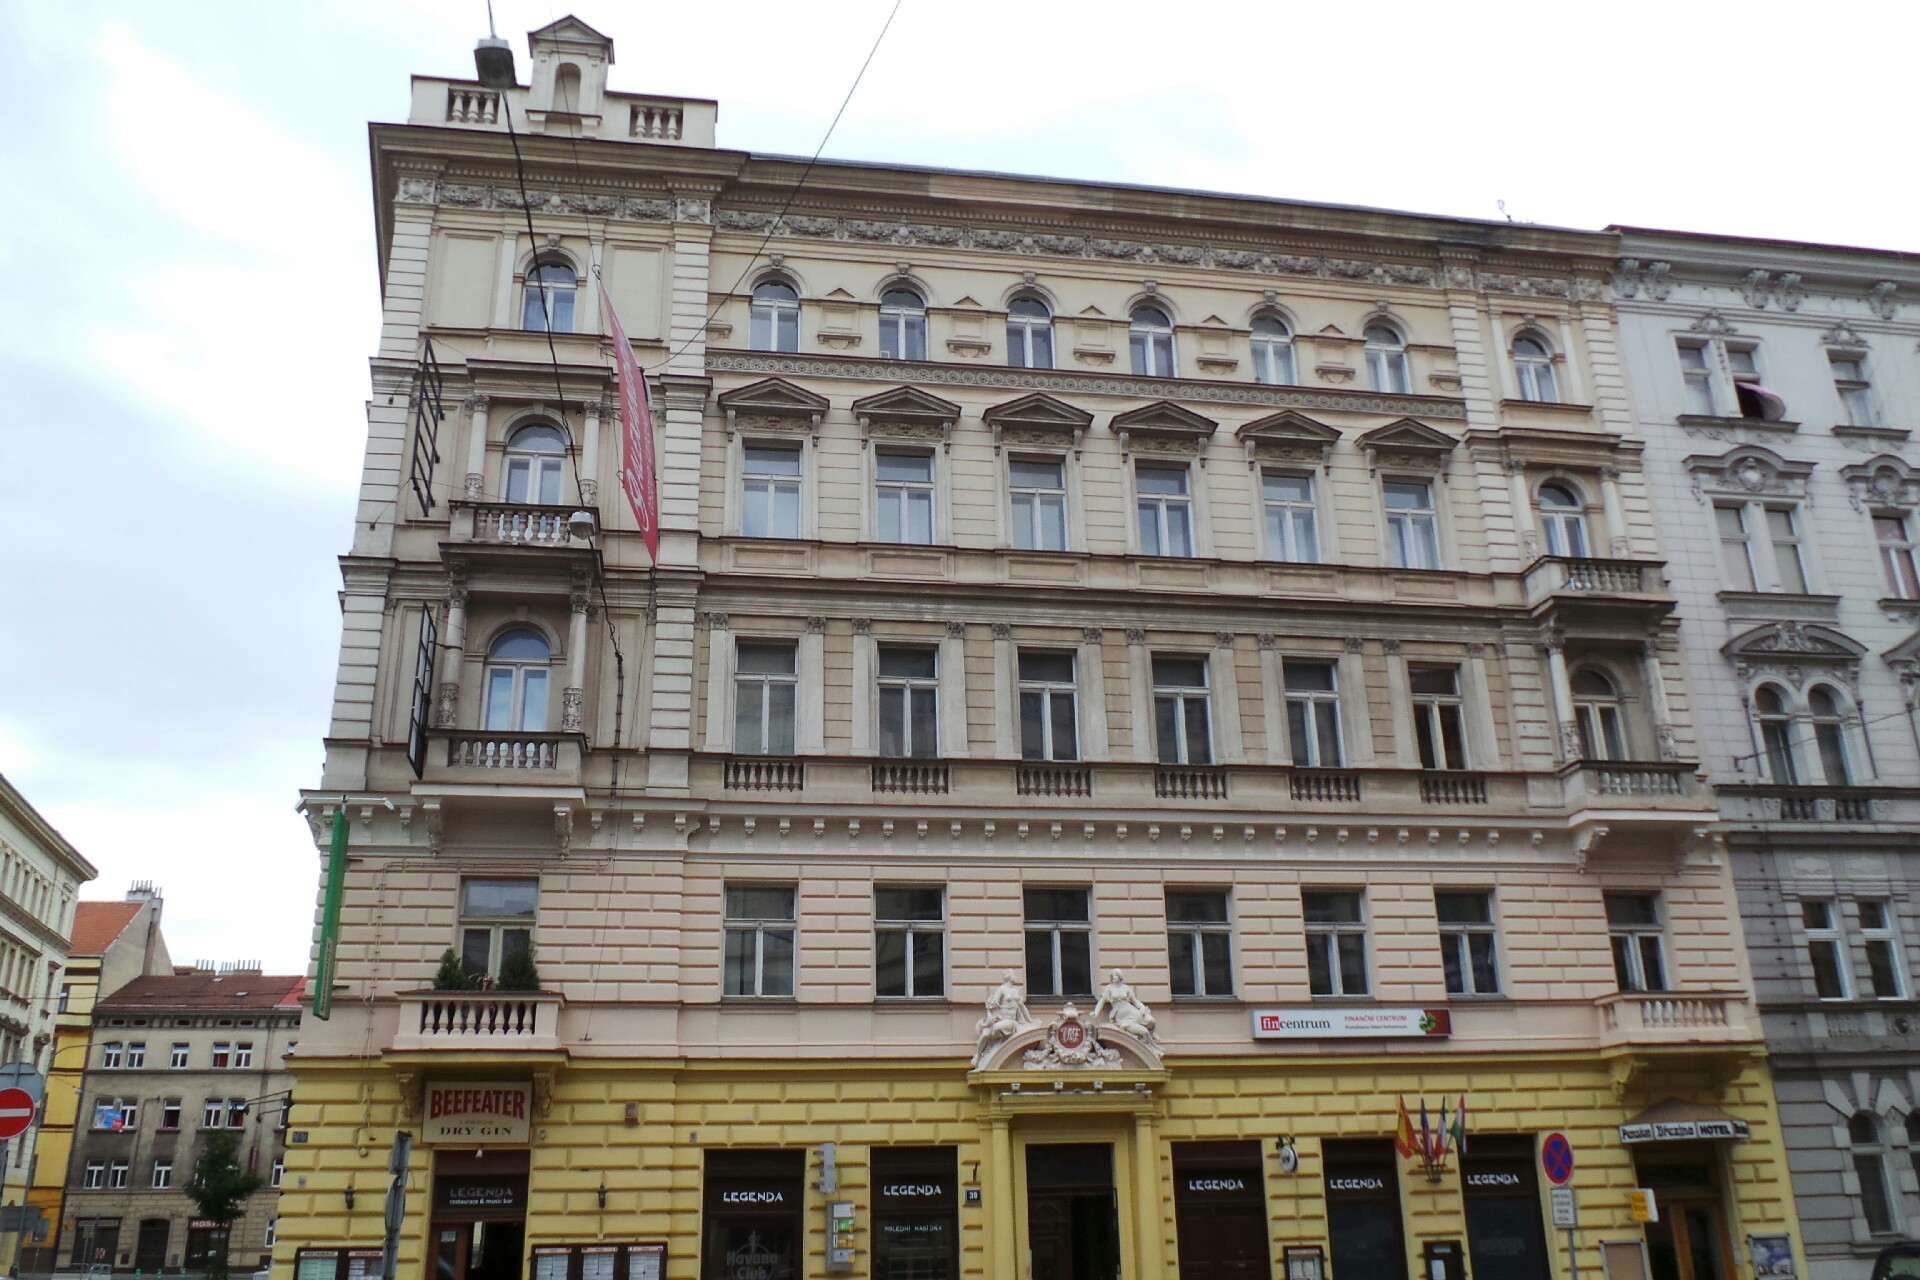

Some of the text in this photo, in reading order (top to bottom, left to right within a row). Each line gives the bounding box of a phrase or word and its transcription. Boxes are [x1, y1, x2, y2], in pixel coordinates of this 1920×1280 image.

[612, 318, 643, 491] ALEXANDR
[1262, 1016, 1331, 1029] fincentrum
[430, 1089, 525, 1120] BEEFEATER
[440, 1127, 512, 1136] DRY GIN
[1700, 1124, 1731, 1135] HOTEL
[1189, 1179, 1244, 1191] LEGENDA
[1329, 1178, 1383, 1190] LEGENDA
[1467, 1173, 1520, 1185] LEGENDA
[450, 1187, 513, 1198] LEGENDA
[883, 1184, 942, 1197] LEGENDA
[969, 1191, 979, 1199] 39
[723, 1191, 784, 1203] LEGENDA
[726, 1250, 778, 1266] Havana
[736, 1265, 767, 1280] Club
